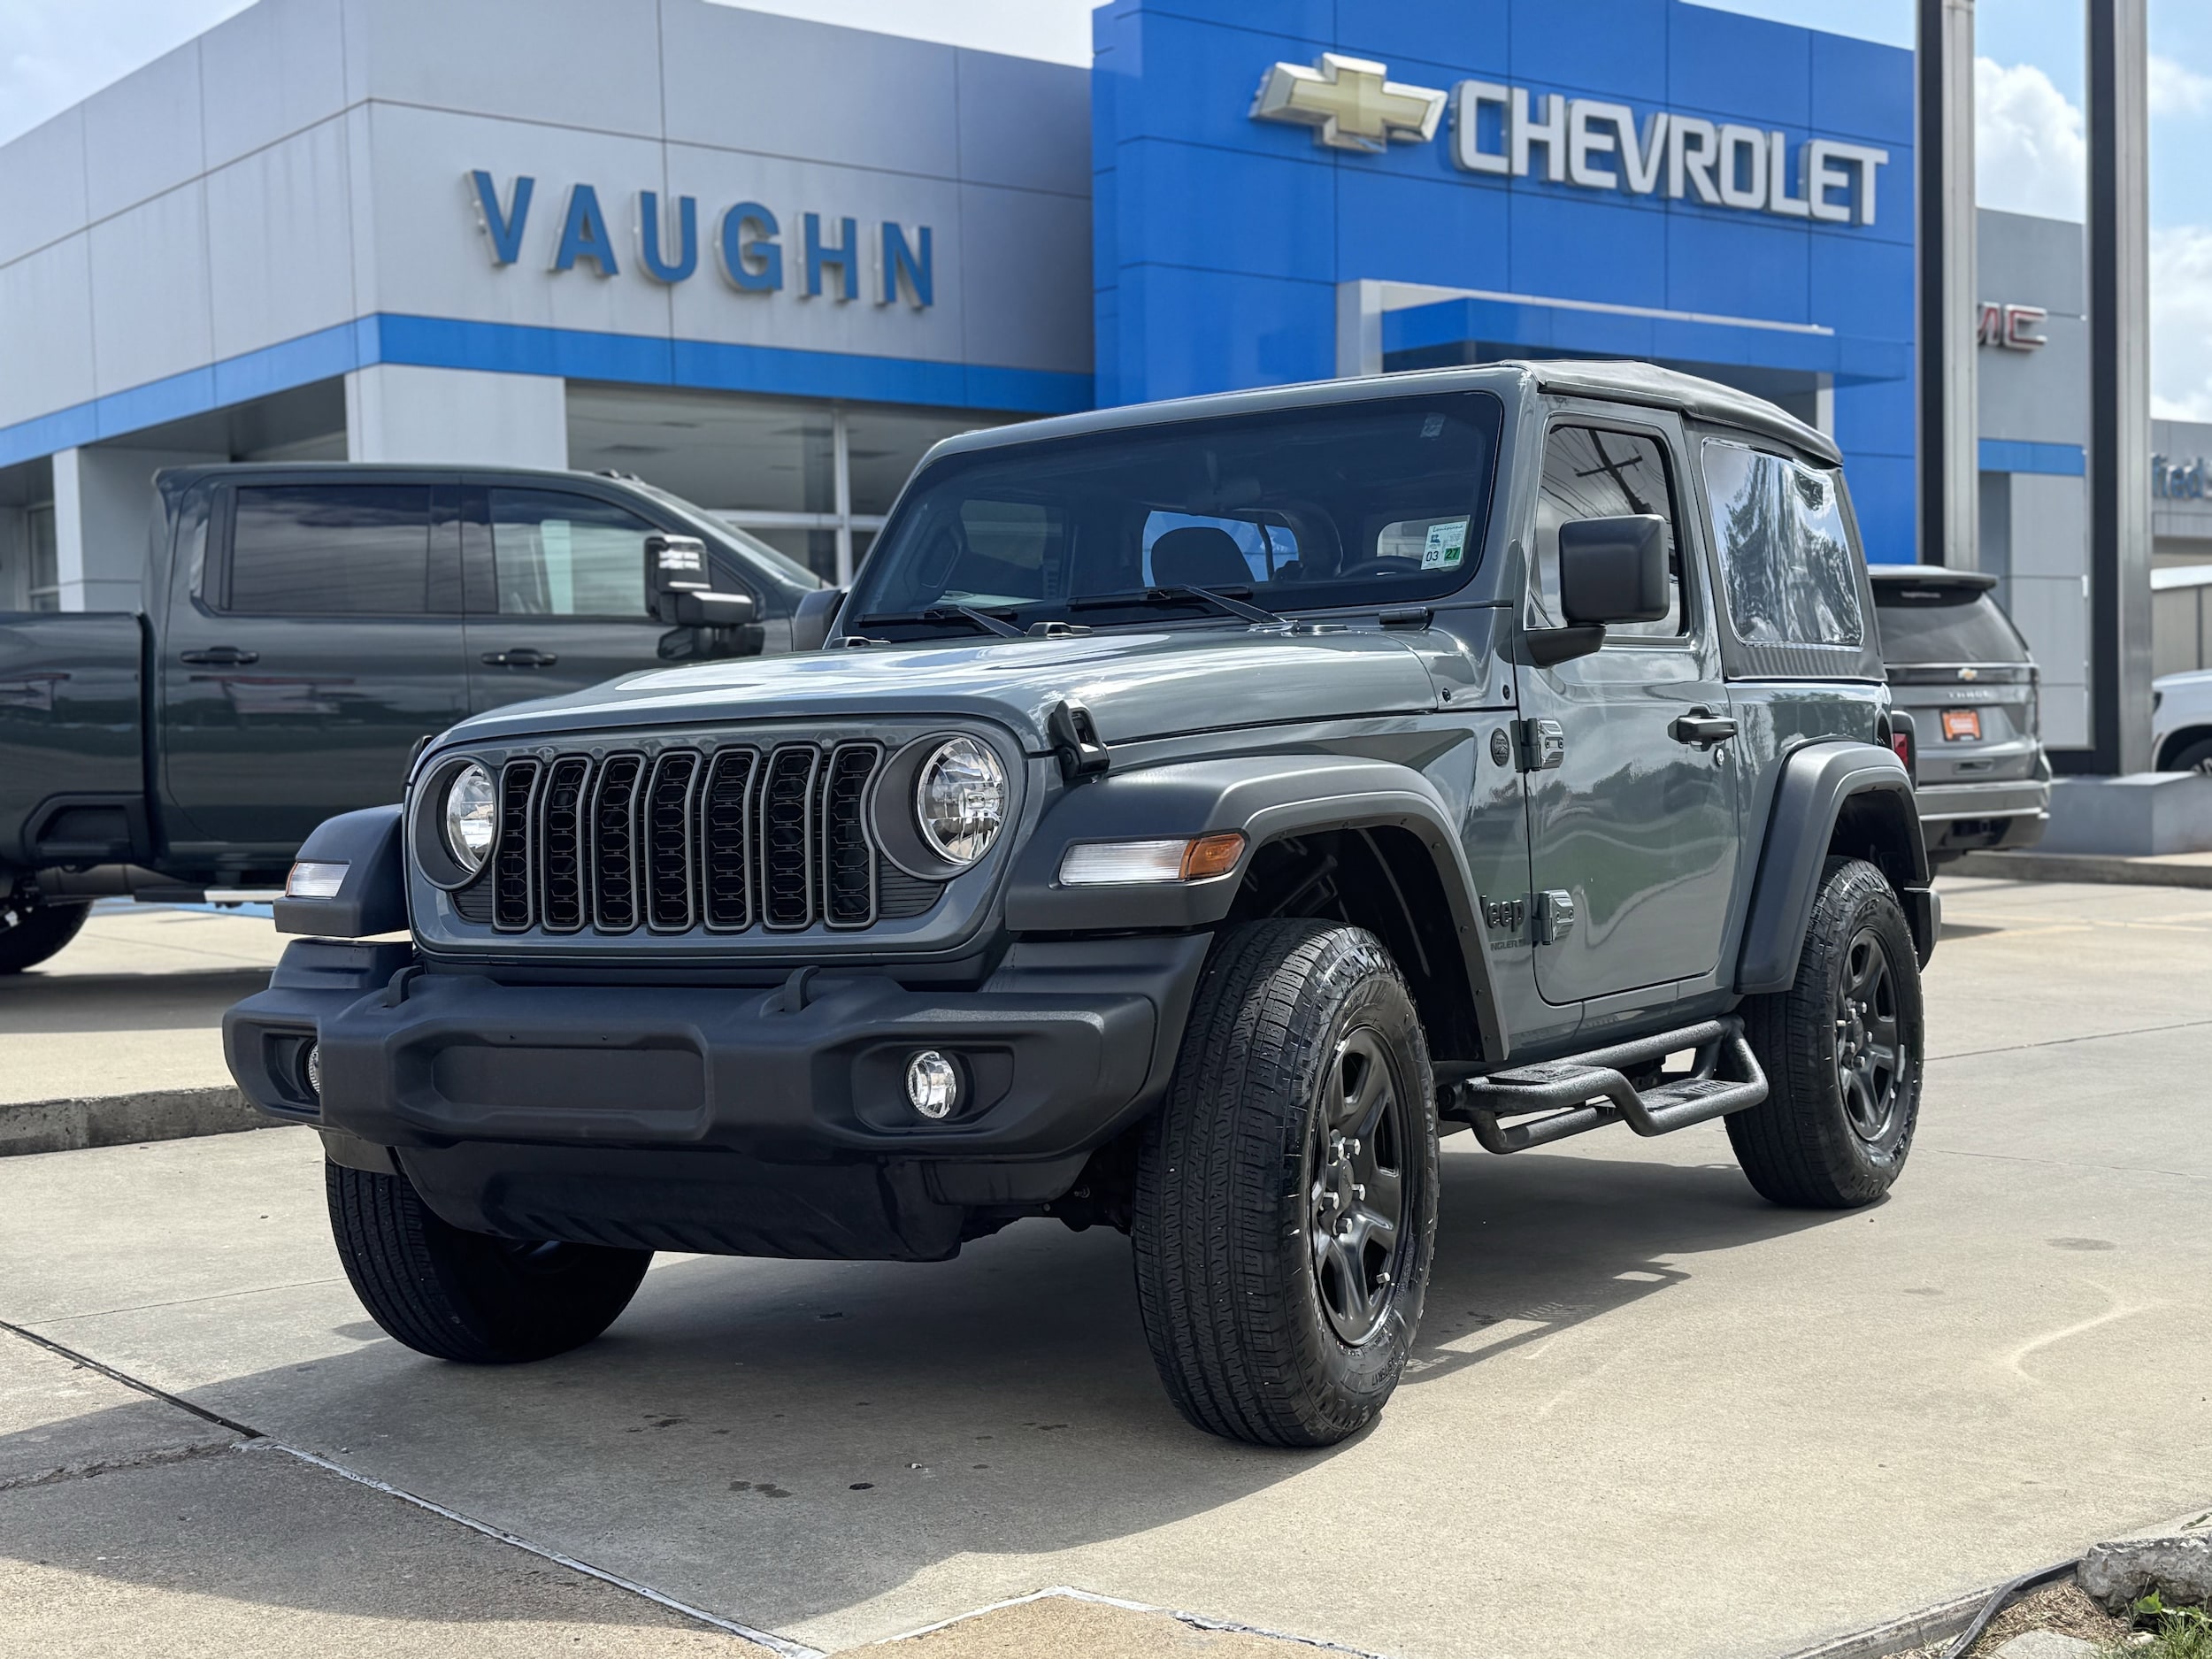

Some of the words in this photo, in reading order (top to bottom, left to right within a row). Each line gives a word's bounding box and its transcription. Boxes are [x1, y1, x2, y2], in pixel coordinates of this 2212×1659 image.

[1451, 80, 1889, 226] CHEVROLET
[466, 170, 934, 308] VAUGHN
[1978, 301, 2047, 350] MC
[1425, 550, 1439, 562] 03
[1446, 548, 1459, 559] 27
[1490, 940, 1519, 951] NGLER
